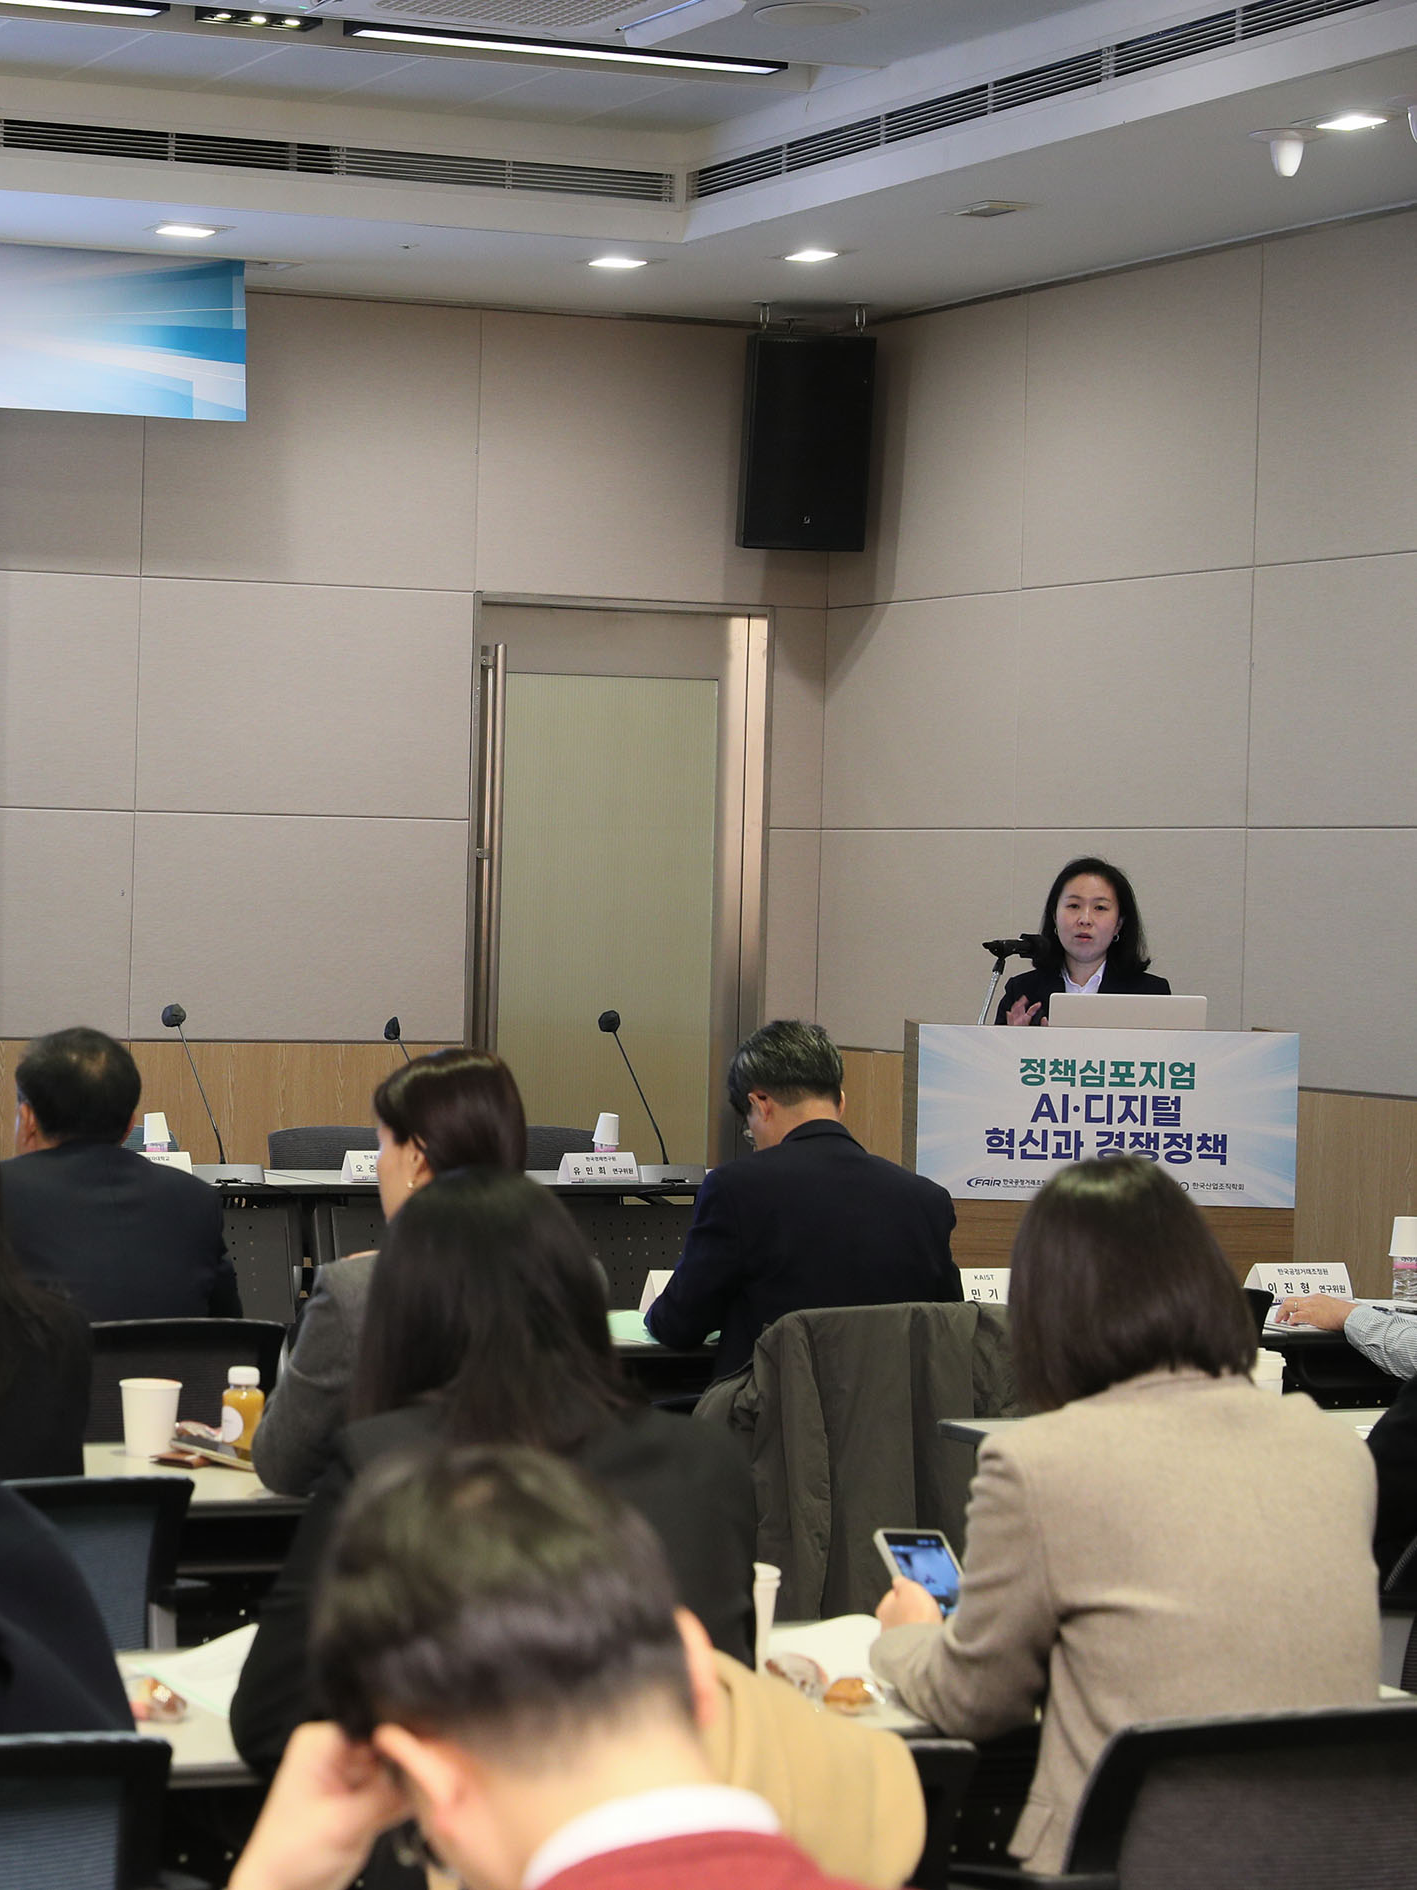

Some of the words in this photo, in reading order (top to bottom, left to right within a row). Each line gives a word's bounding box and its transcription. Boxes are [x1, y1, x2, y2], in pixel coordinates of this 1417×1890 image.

[1020, 1059, 1195, 1090] 정책심포지엄
[985, 1128, 1084, 1161] 혁신과
[1095, 1130, 1228, 1166] 경쟁정책
[1318, 1284, 1346, 1294] 연구위원
